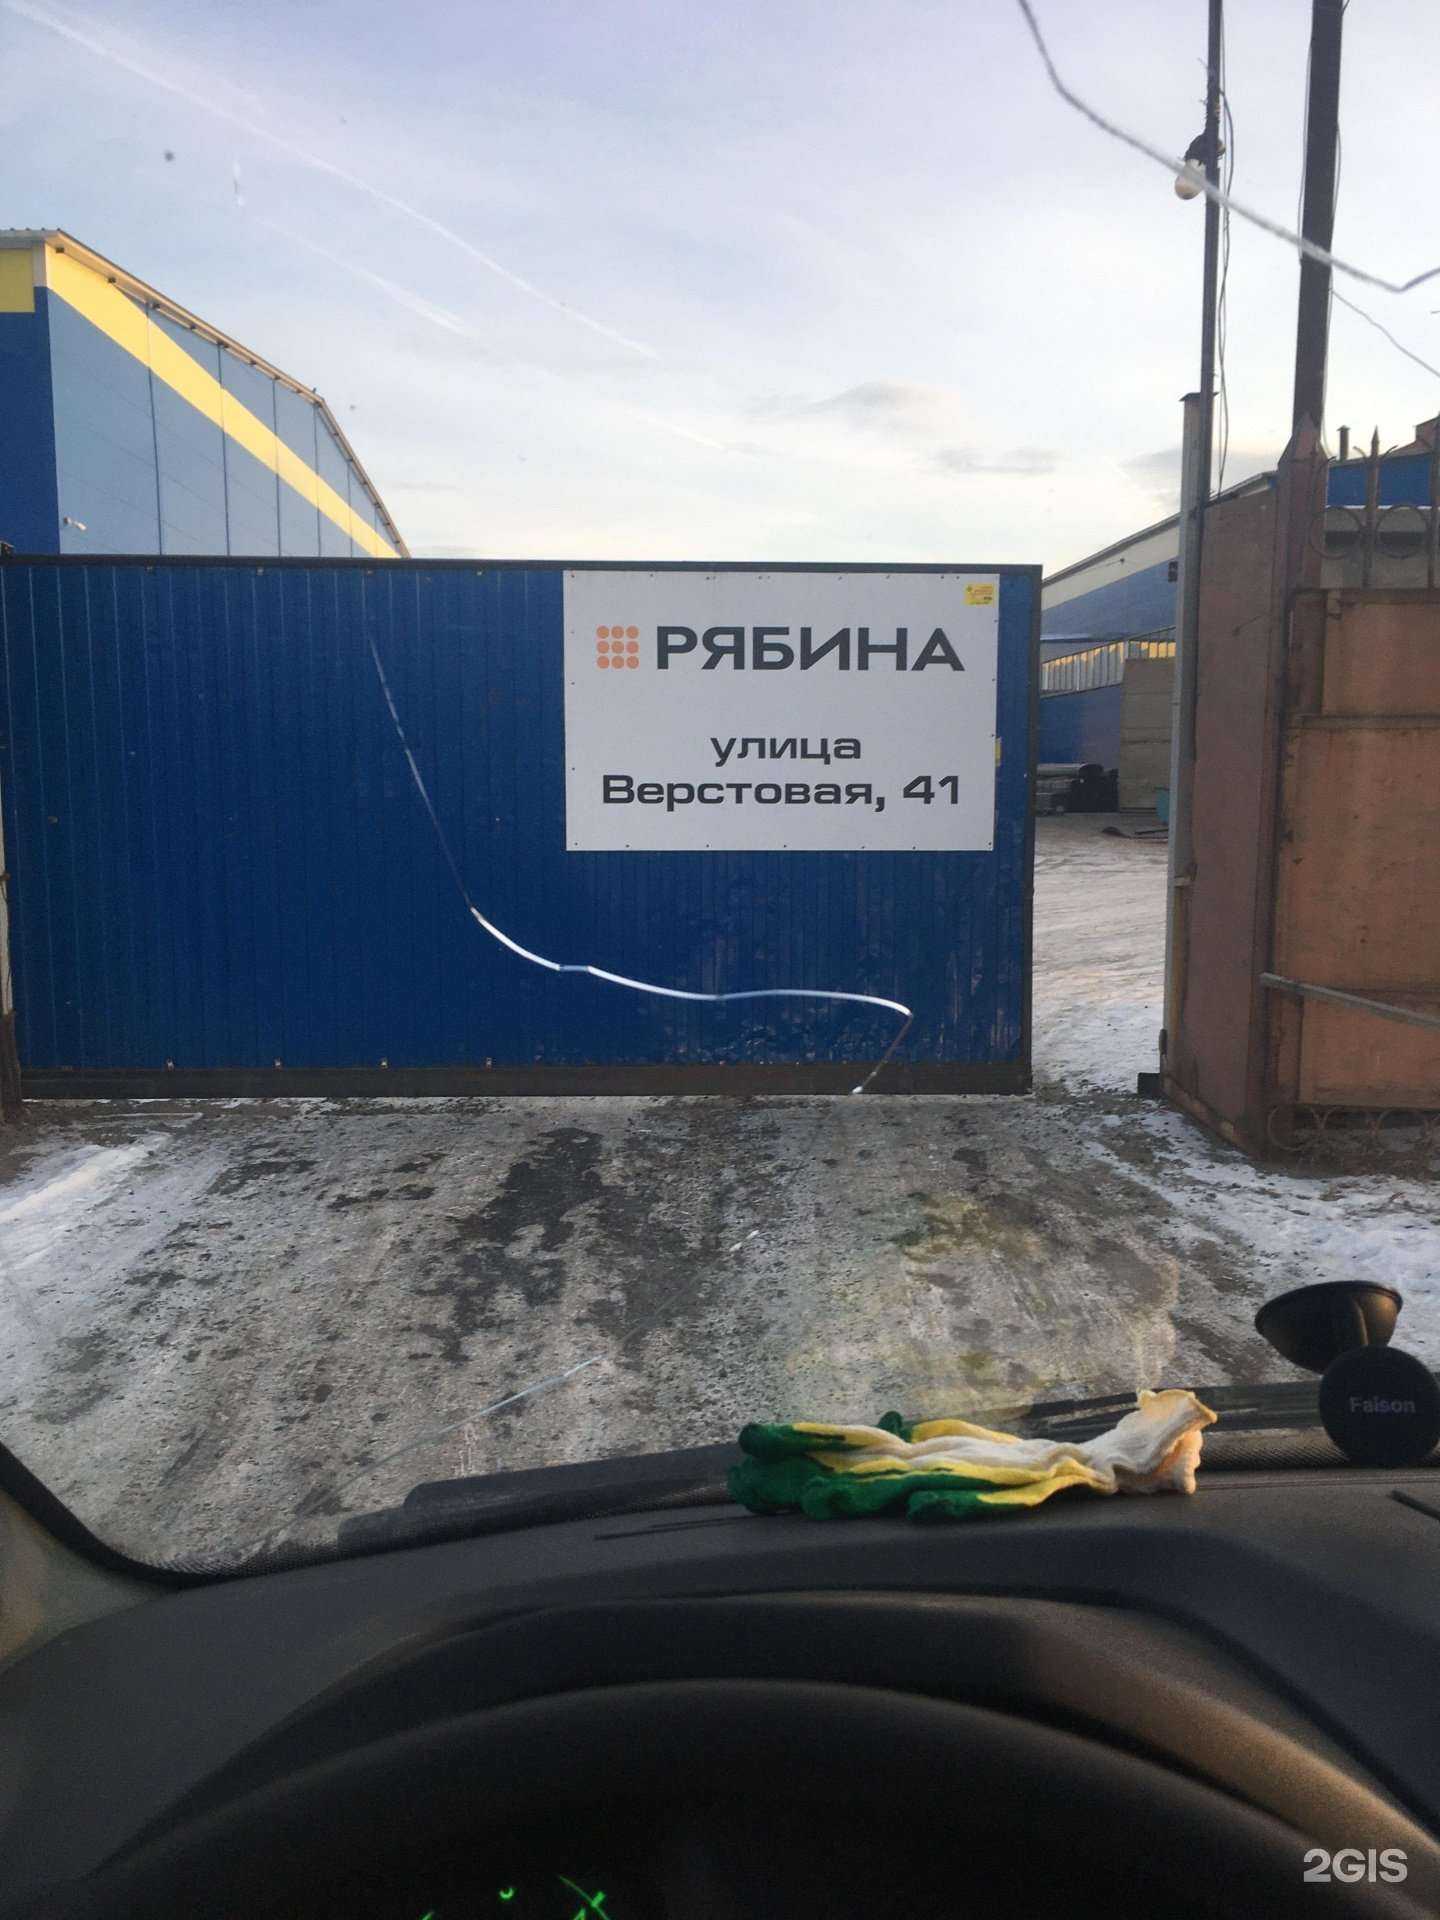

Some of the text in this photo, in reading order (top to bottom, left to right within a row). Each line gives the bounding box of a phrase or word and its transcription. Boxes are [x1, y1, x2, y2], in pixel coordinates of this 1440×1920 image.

[656, 625, 966, 672] РЯБИНА
[710, 737, 862, 768] улица
[602, 774, 959, 813] Верстовая, 41
